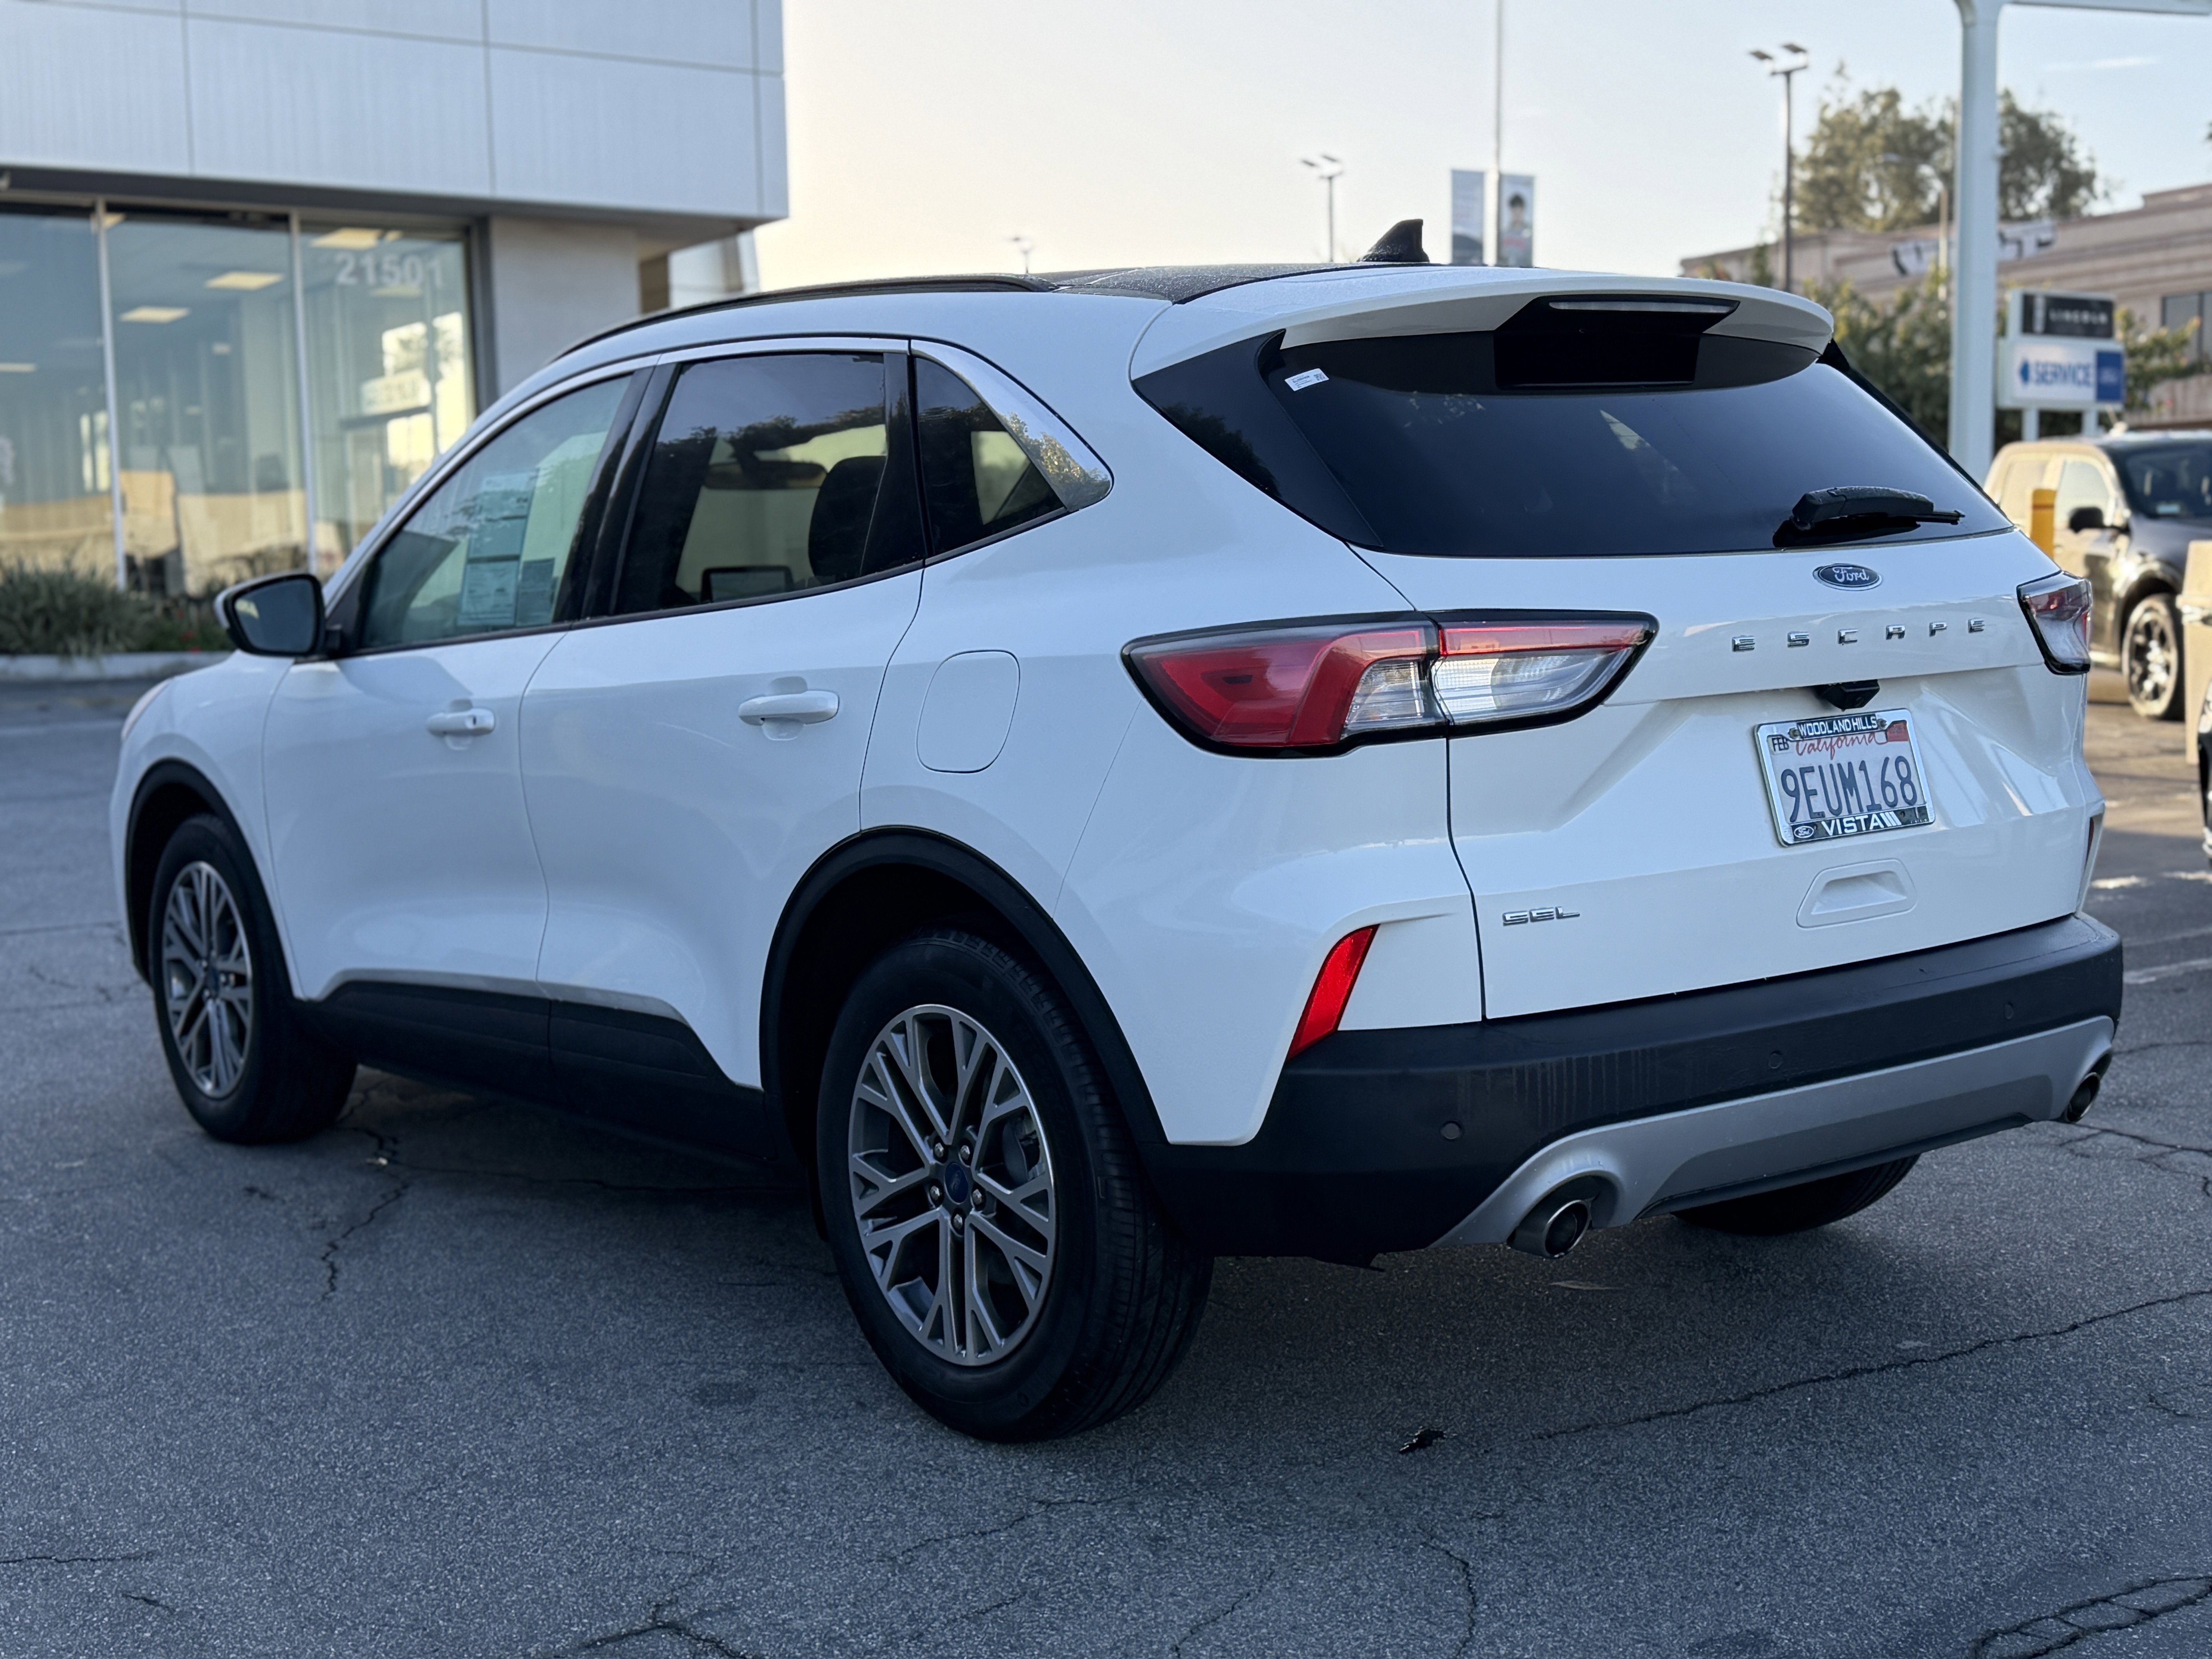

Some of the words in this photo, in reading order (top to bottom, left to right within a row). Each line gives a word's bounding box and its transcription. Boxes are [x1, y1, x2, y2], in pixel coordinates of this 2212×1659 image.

[335, 252, 443, 289] 21501
[2034, 361, 2092, 386] SERVICE
[1832, 567, 1869, 582] Ford
[1732, 617, 1985, 652] ESCAPE
[1798, 719, 1851, 736] WOODLAND
[1851, 716, 1878, 731] HILLS
[1772, 736, 1789, 752] FEB
[1796, 732, 1885, 759] California
[1781, 755, 1917, 822] 9EUM168
[1821, 812, 1884, 836] VISTA
[1503, 906, 1580, 926] SEL
